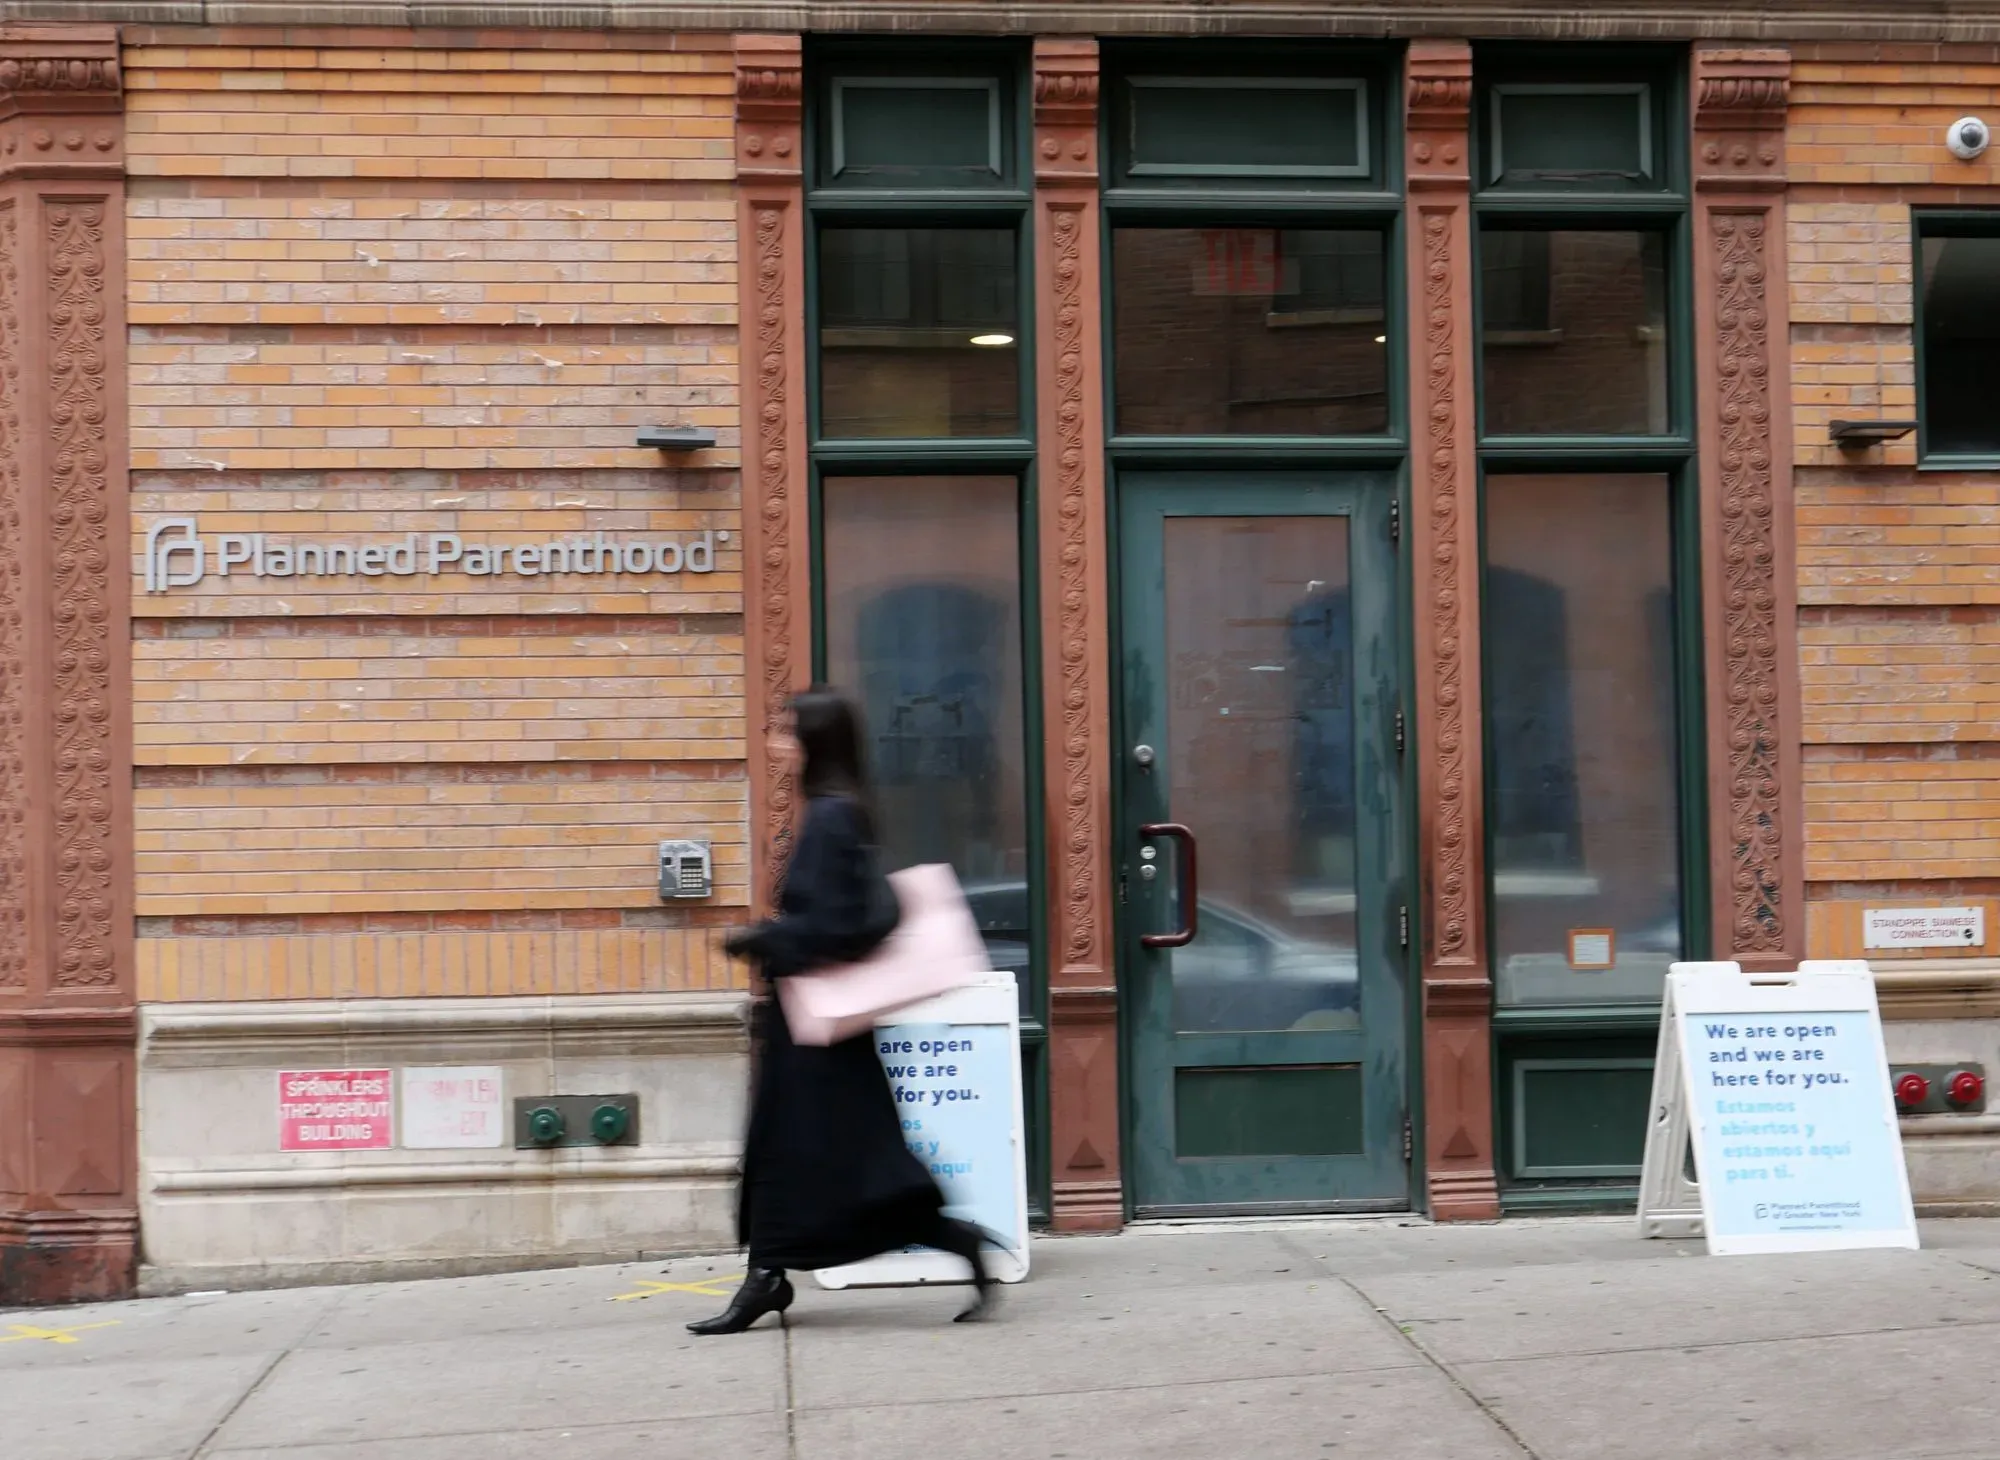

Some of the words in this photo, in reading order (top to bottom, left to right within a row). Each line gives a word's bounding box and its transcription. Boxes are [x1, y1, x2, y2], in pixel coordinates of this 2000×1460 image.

[217, 533, 417, 577] Planned
[428, 531, 714, 576] Parenthood
[1890, 929, 1959, 939] CONNECTION
[1704, 1023, 1739, 1039] We
[1745, 1025, 1778, 1038] are
[1784, 1024, 1837, 1042] open
[880, 1040, 913, 1054] are
[919, 1038, 973, 1057] open
[1709, 1046, 1748, 1063] and
[1753, 1049, 1786, 1062] we
[1792, 1048, 1825, 1062] are
[886, 1064, 917, 1078] we
[924, 1063, 958, 1078] are
[1712, 1070, 1760, 1087] here
[1765, 1069, 1797, 1086] for
[1802, 1071, 1849, 1089] you.
[286, 1079, 384, 1097] SPRINKLERS
[895, 1085, 926, 1103] for
[931, 1087, 981, 1106] you.
[281, 1101, 390, 1119] THROUGHOUT
[1715, 1099, 1797, 1115] Estamos
[299, 1124, 373, 1141] BUILDING
[1720, 1120, 1800, 1137] abiertos
[1804, 1122, 1816, 1139] y
[928, 1140, 940, 1156] y
[1722, 1144, 1804, 1159] estamos
[1726, 1168, 1769, 1185] para
